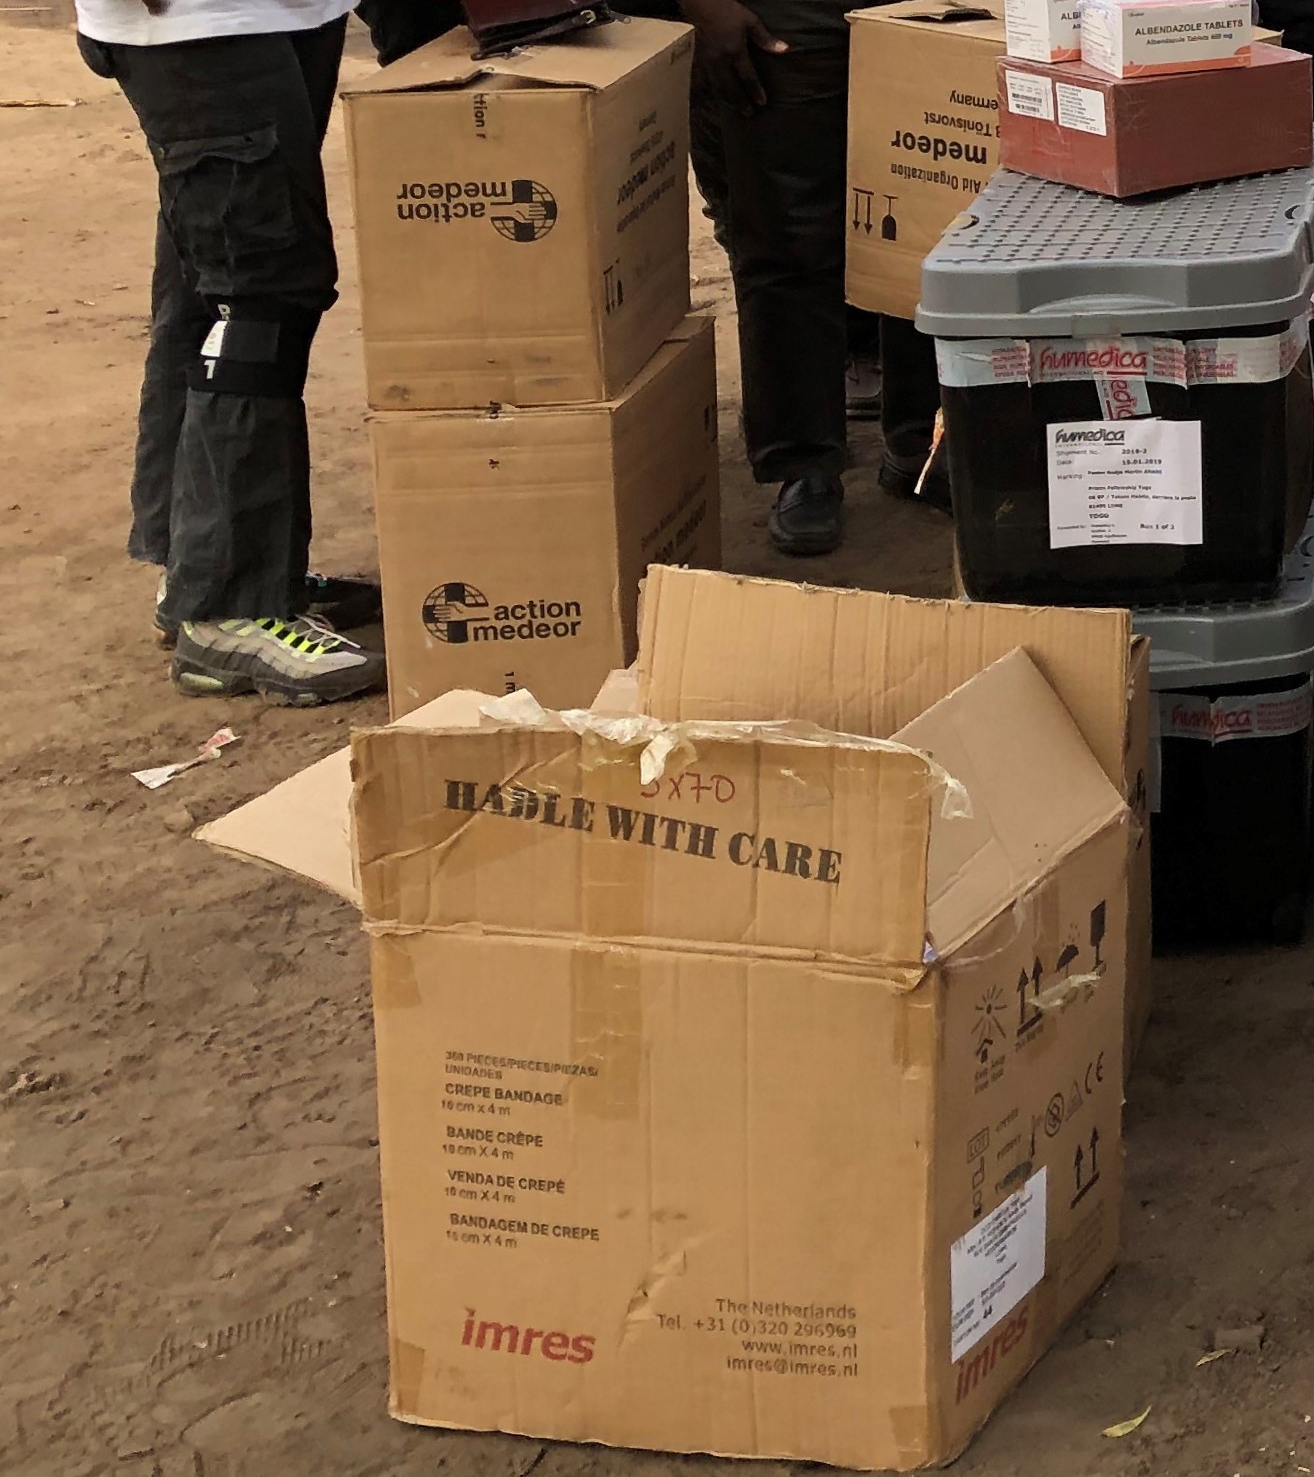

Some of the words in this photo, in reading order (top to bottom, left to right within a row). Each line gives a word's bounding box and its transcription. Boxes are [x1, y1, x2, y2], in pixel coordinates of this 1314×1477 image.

[1135, 23, 1202, 36] ALBENDAZOLE
[1205, 19, 1244, 31] TABLETS
[924, 111, 992, 137] Tönisvorst
[891, 130, 987, 165] medeor
[890, 161, 959, 191] Organization
[962, 177, 982, 194] Aid
[397, 180, 507, 200] medeor
[397, 201, 486, 224] action
[1040, 345, 1147, 371] humedica
[1055, 428, 1126, 444] humedica
[494, 598, 582, 621] action
[473, 619, 582, 642] medeor
[607, 804, 719, 860] WITH
[728, 832, 843, 884] CARE
[445, 1064, 503, 1080] UNIDADES
[445, 1082, 491, 1099] CREPE
[494, 1087, 564, 1107] BANDAGE
[487, 1103, 496, 1114] 4
[446, 1125, 494, 1143] BANDE
[491, 1147, 499, 1159] 4
[447, 1170, 494, 1186] VENDA
[497, 1175, 515, 1189] DE
[518, 1177, 566, 1194] CREPÉ
[491, 1191, 500, 1202] 4
[450, 1213, 528, 1234] BANDAGEM
[530, 1222, 549, 1237] DE
[552, 1225, 600, 1242] CREPE
[716, 1298, 747, 1315] The
[752, 1299, 857, 1320] Netherlands
[460, 1305, 598, 1366] imres
[656, 1313, 686, 1331] Tel.
[693, 1318, 727, 1333] +31
[793, 1321, 858, 1339] 296969
[740, 1338, 859, 1359] www.imres.nl
[726, 1355, 860, 1379] imres@imres.nl
